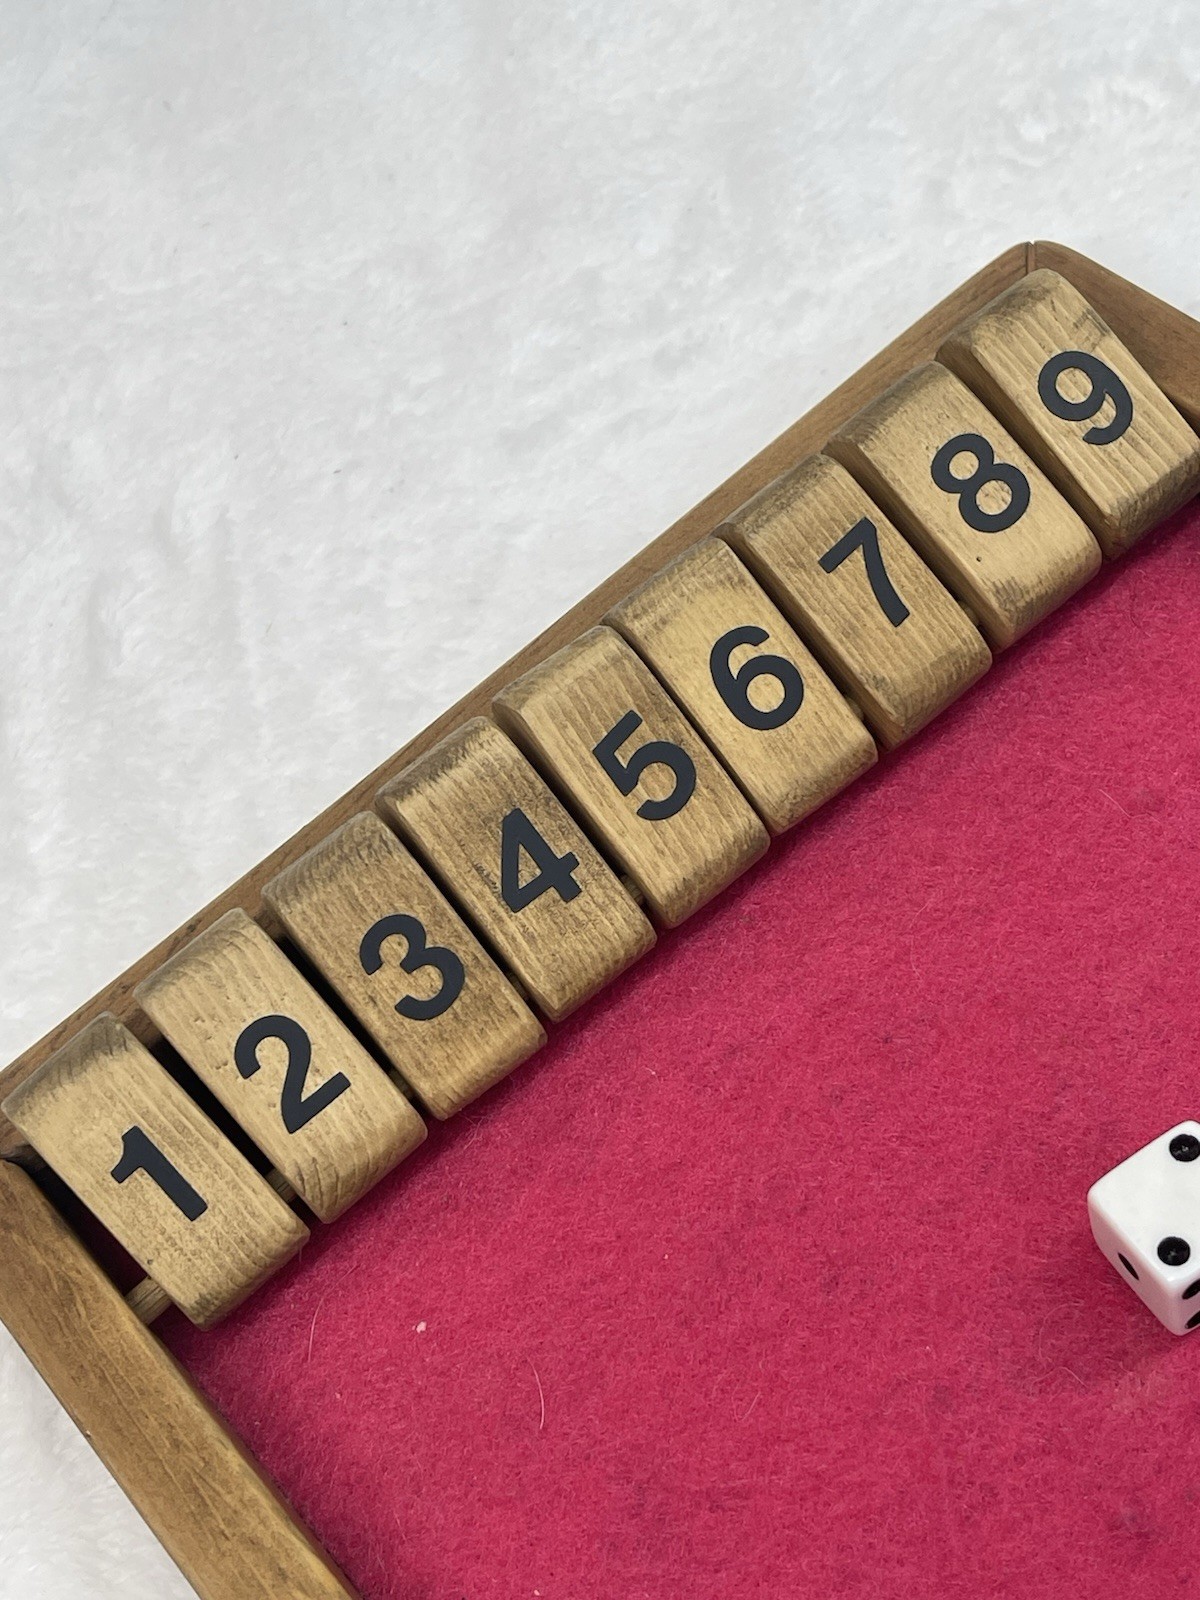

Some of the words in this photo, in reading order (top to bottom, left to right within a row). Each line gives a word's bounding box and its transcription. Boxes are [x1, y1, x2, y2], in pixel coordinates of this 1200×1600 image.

[1037, 350, 1134, 446] 9
[930, 432, 1031, 533] 8
[819, 517, 910, 627] 7
[710, 625, 804, 730] 6
[593, 711, 696, 821] 5
[500, 807, 581, 913] 4
[360, 914, 465, 1021] 3
[234, 1014, 350, 1133] 2
[111, 1126, 207, 1222] 1
